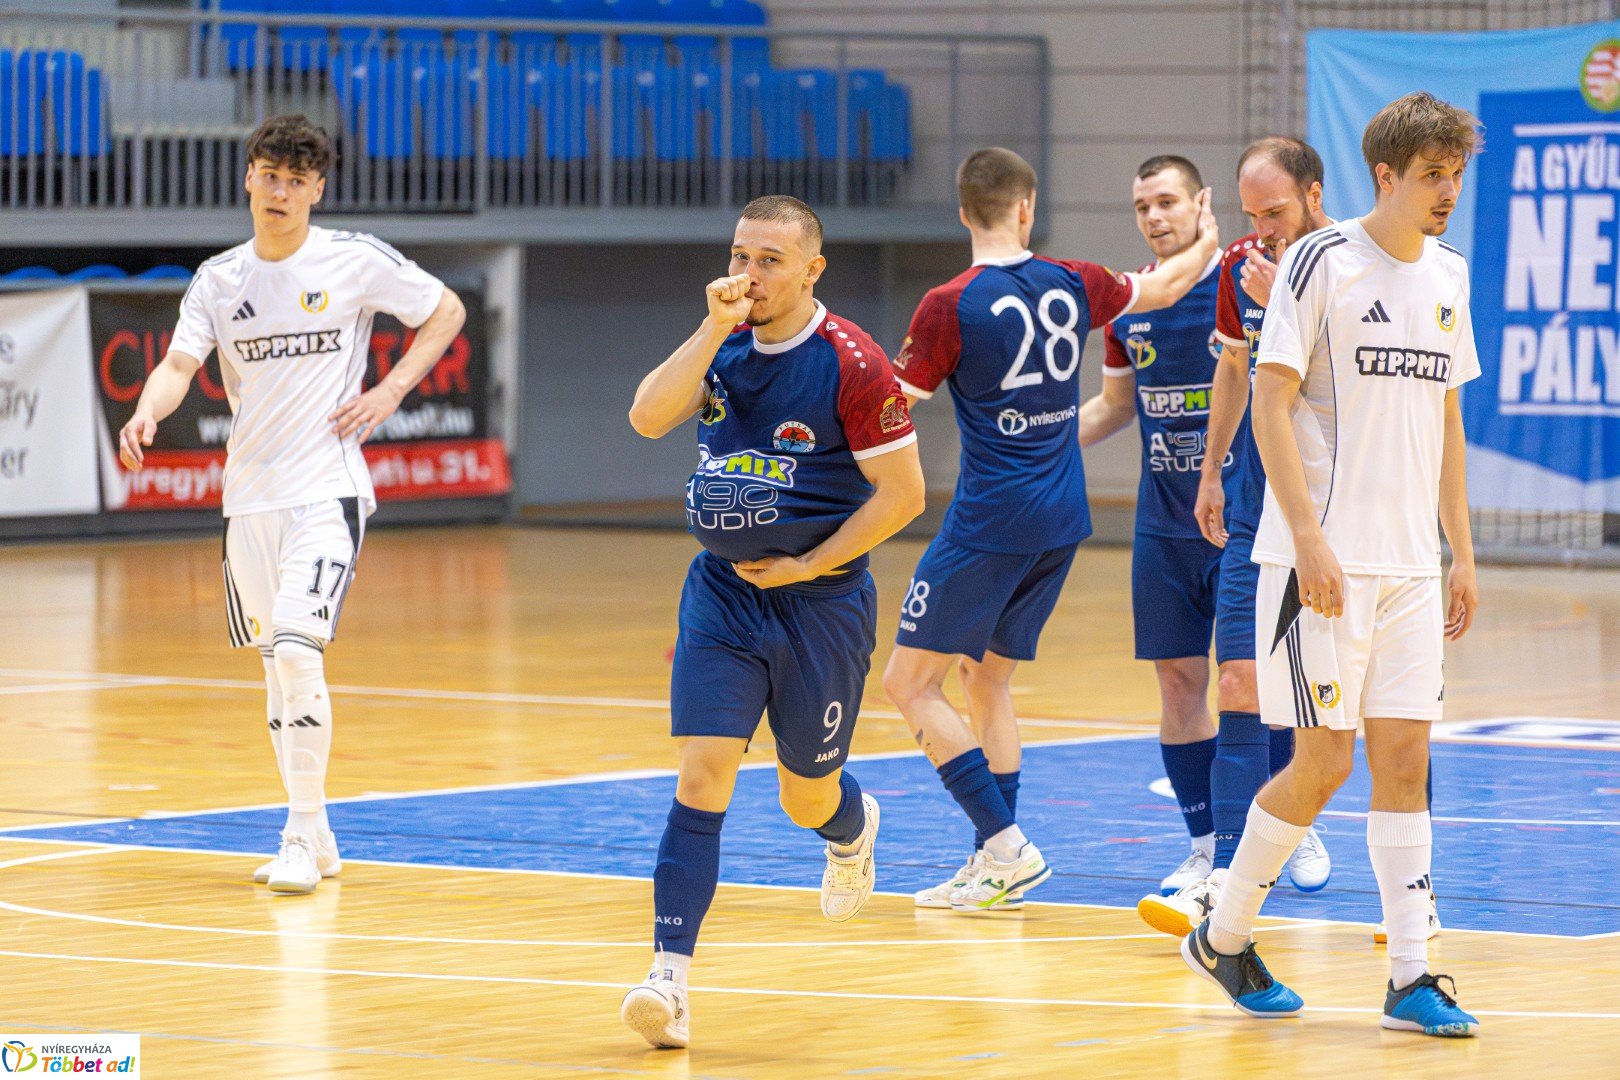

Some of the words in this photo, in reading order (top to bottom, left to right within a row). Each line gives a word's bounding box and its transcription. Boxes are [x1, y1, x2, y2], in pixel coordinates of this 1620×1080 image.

[1511, 144, 1537, 191] A
[1503, 194, 1620, 311] NE
[1244, 308, 1264, 320] JAKO
[990, 289, 1080, 391] 28
[1150, 452, 1234, 472] STUDO
[686, 507, 779, 530] TUDIO
[307, 556, 349, 601] 17
[823, 701, 842, 743] 9
[814, 747, 840, 763] JAKO
[1181, 802, 1206, 814] AKO
[655, 915, 683, 926] AKO
